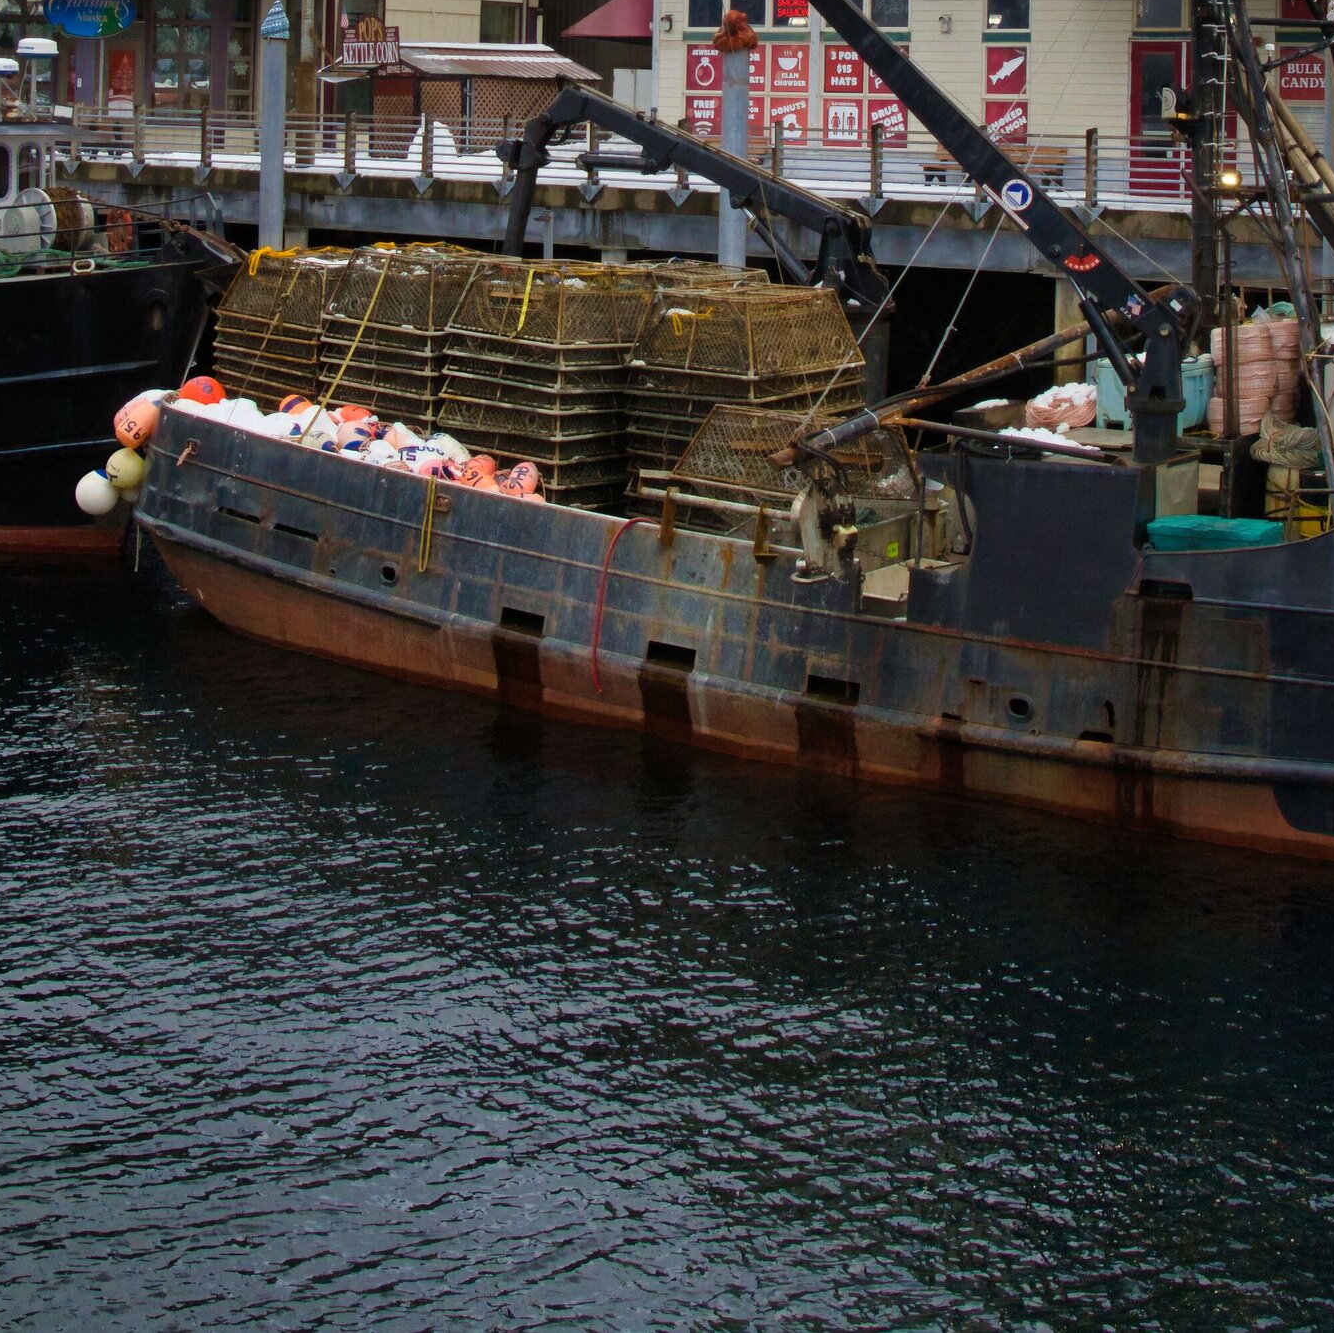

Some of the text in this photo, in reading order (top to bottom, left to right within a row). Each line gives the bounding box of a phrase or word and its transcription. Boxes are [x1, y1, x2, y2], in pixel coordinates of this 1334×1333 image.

[77, 11, 107, 22] Alaska
[777, 7, 809, 17] SALMON
[343, 42, 399, 64] KETTLE CORN
[830, 51, 859, 60] 3 FOR
[836, 63, 853, 74] $15
[1287, 63, 1322, 74] BULK
[830, 76, 858, 86] HATS
[693, 99, 715, 108] FREE
[771, 101, 807, 116] DONUTS
[693, 109, 715, 119] WIFI
[870, 103, 899, 121] DRUG
